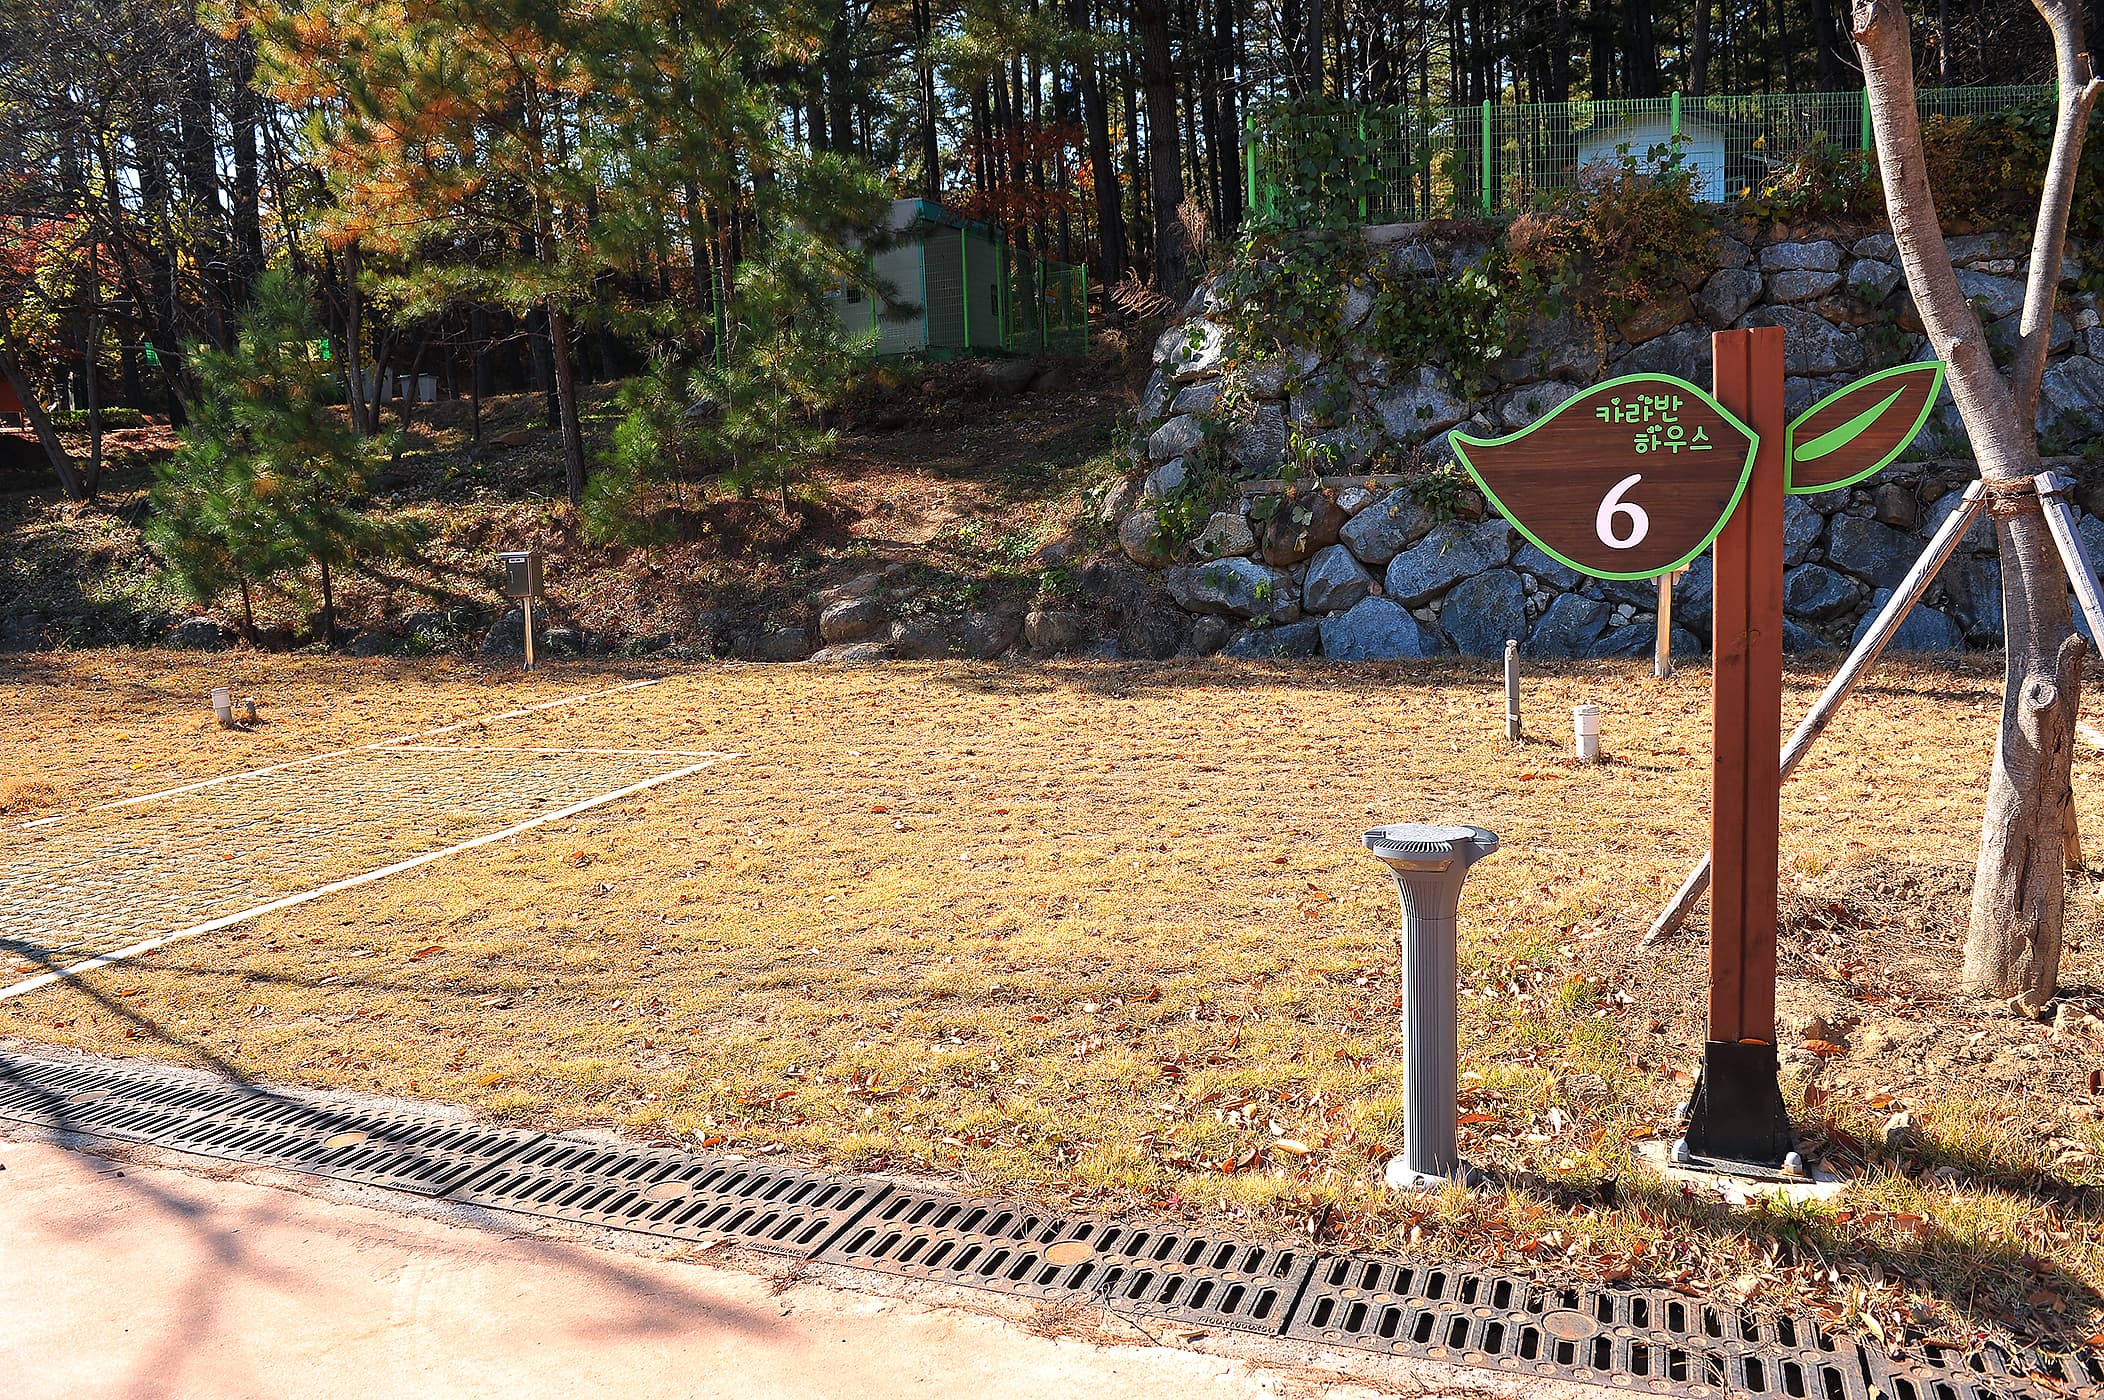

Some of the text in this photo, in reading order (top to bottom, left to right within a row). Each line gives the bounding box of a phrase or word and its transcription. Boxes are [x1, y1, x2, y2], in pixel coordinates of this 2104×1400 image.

[1595, 394, 1684, 423] 카라반
[1633, 424, 1713, 454] 하우스
[1595, 473, 1649, 549] 6
